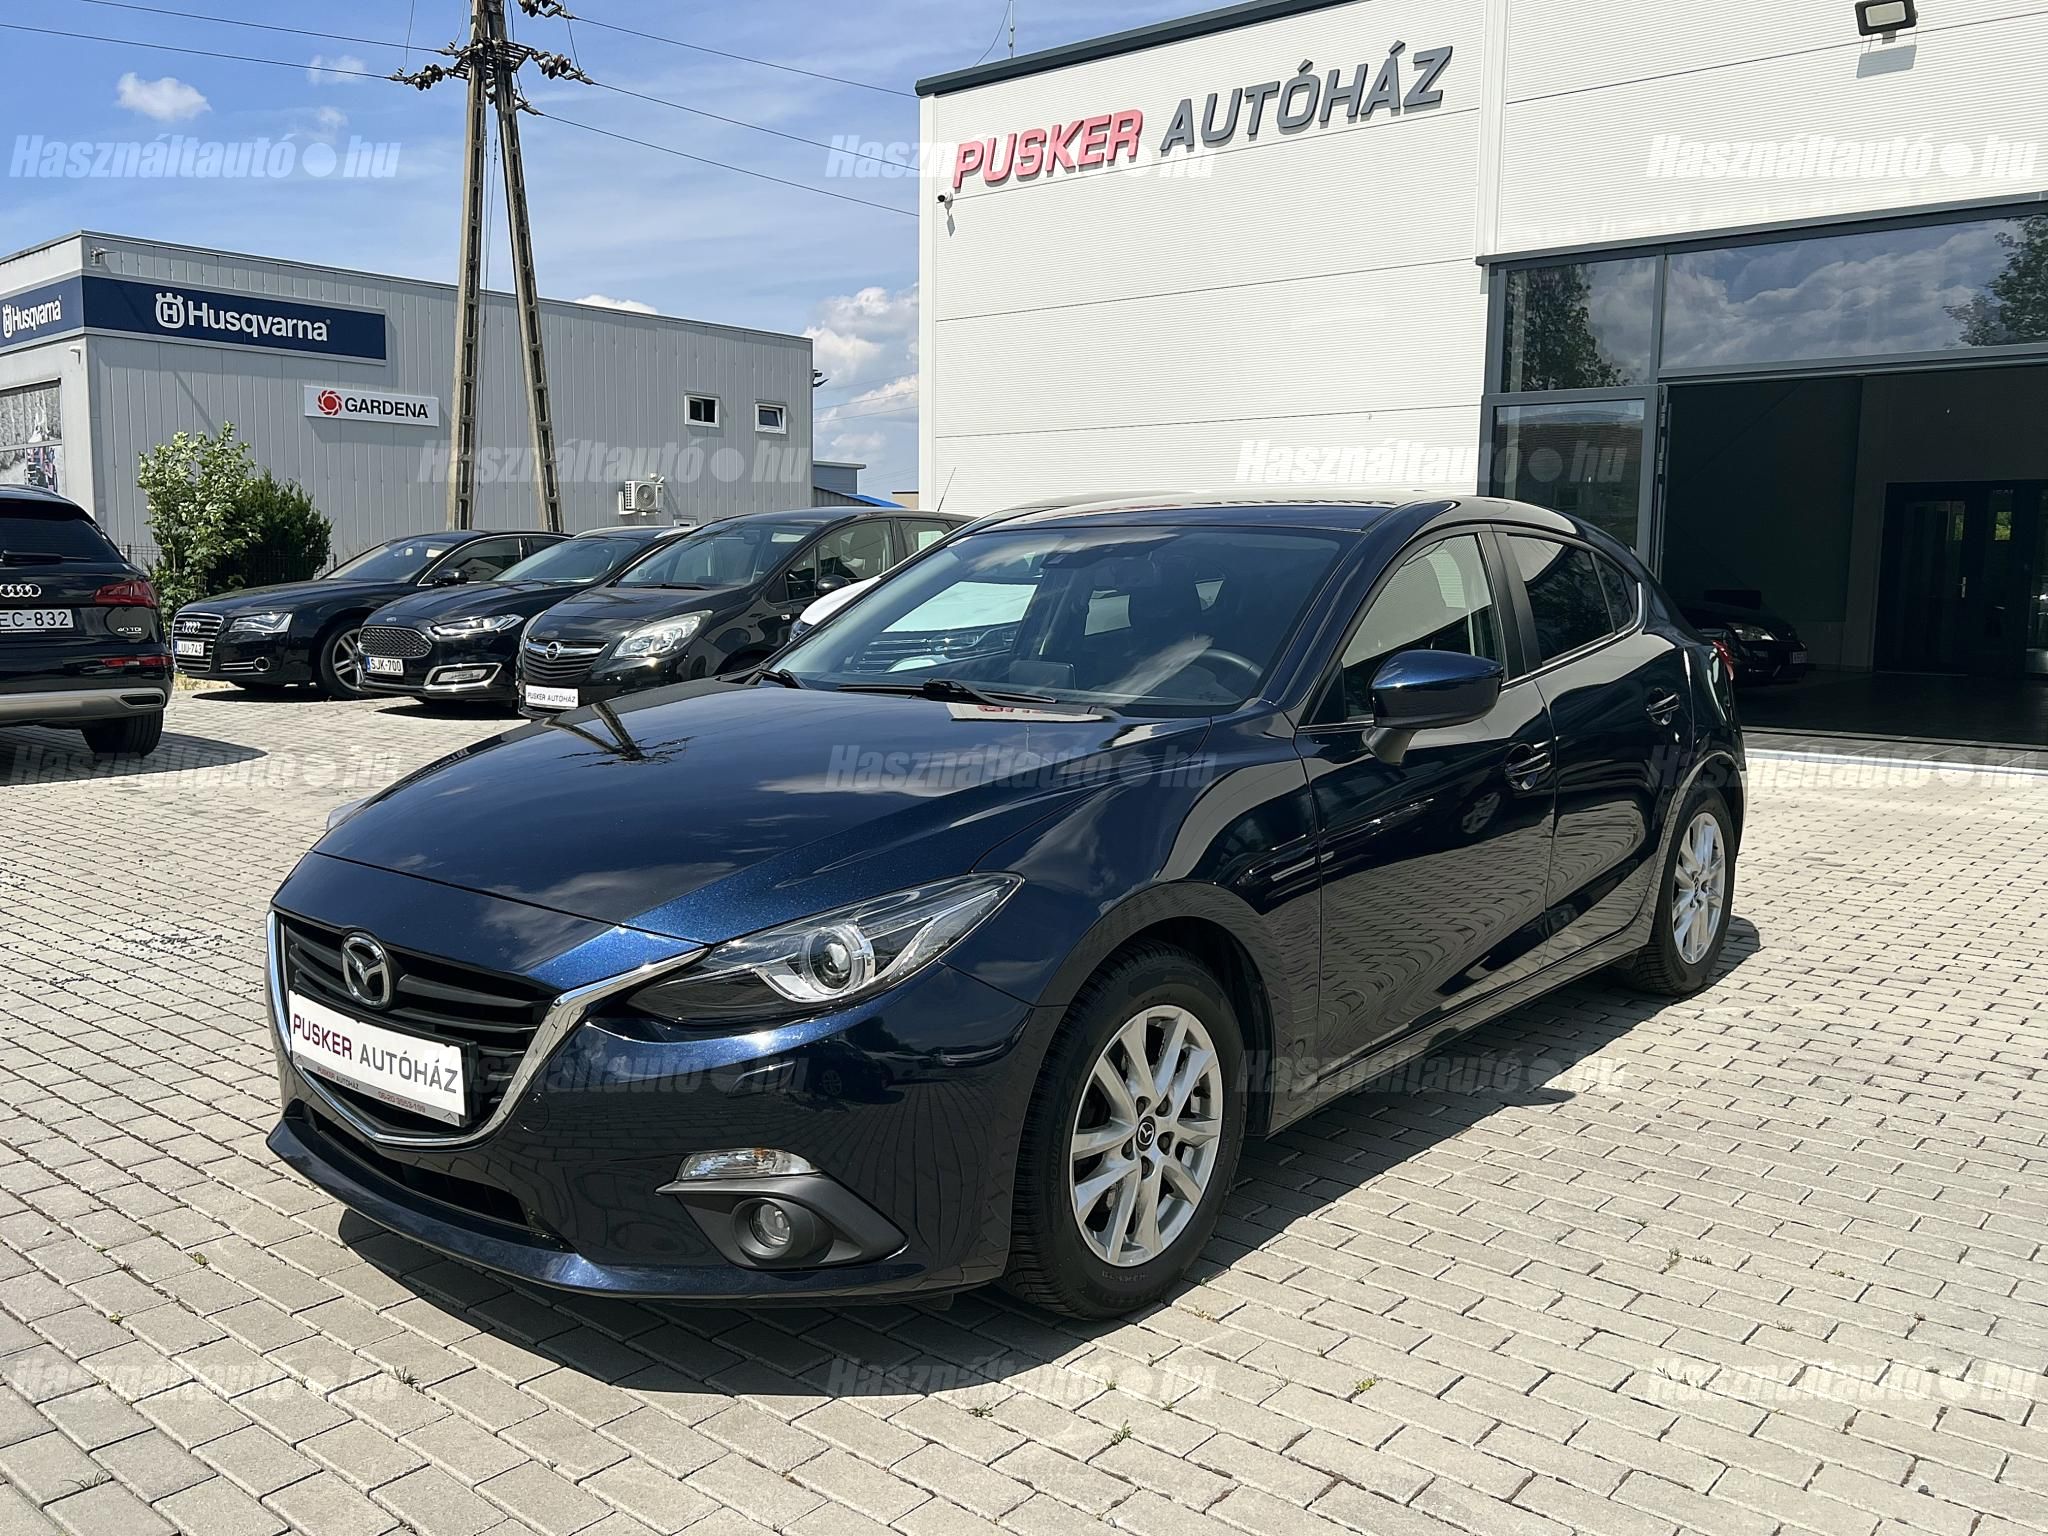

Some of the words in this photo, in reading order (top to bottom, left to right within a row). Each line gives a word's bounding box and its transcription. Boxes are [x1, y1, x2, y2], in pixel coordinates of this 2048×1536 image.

[952, 109, 1144, 190] PUSKER
[1160, 40, 1453, 153] AUTÓHÁZ
[12, 299, 62, 332] Husqvarna
[187, 300, 329, 342] Husqvarna
[344, 397, 429, 418] GARDENA
[370, 658, 402, 673] SJK-700
[527, 691, 546, 701] PUSKER
[292, 1013, 353, 1061] PUSKER
[359, 1042, 458, 1094] AUTÓHÁZ
[316, 1065, 336, 1079] PUSKER
